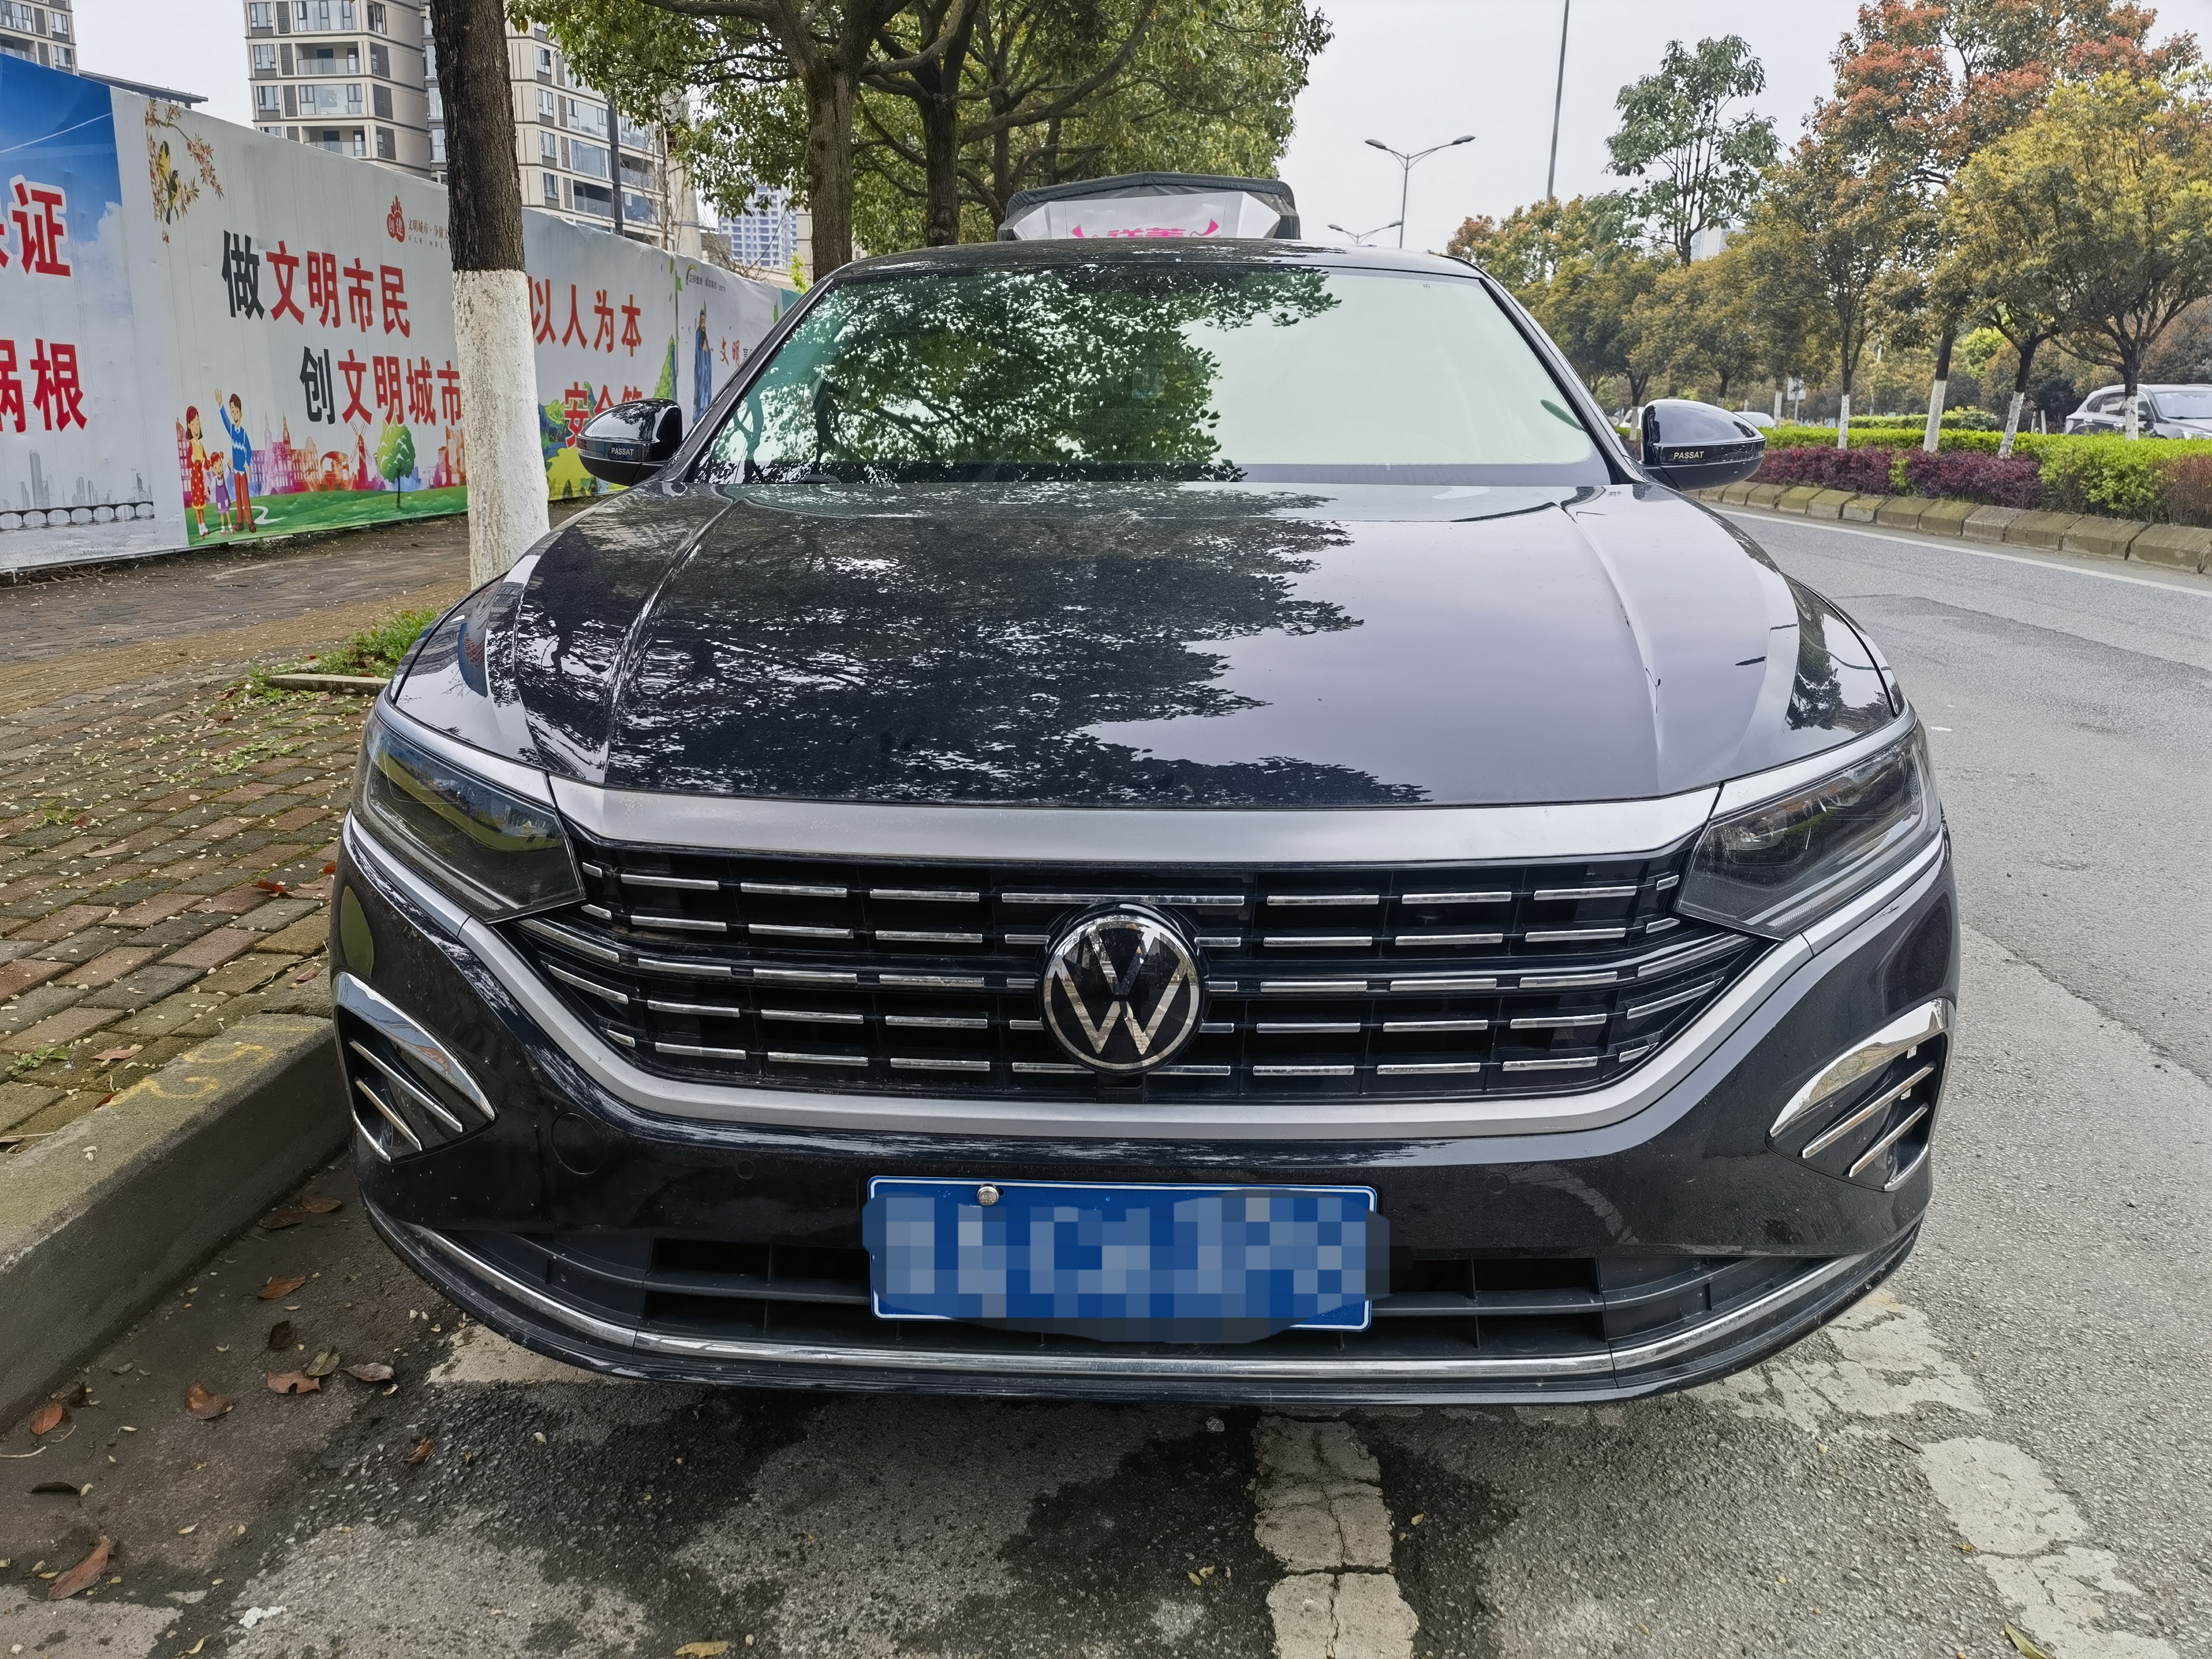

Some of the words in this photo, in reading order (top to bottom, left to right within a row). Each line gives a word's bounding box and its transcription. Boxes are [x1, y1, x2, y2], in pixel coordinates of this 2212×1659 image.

[0, 182, 71, 277] 证
[221, 230, 410, 338] 做文明市民
[527, 275, 642, 357] 以人为本
[299, 346, 462, 426] 创文明城市
[611, 447, 634, 456] PASSAT
[1674, 451, 1704, 459] PASSAT
